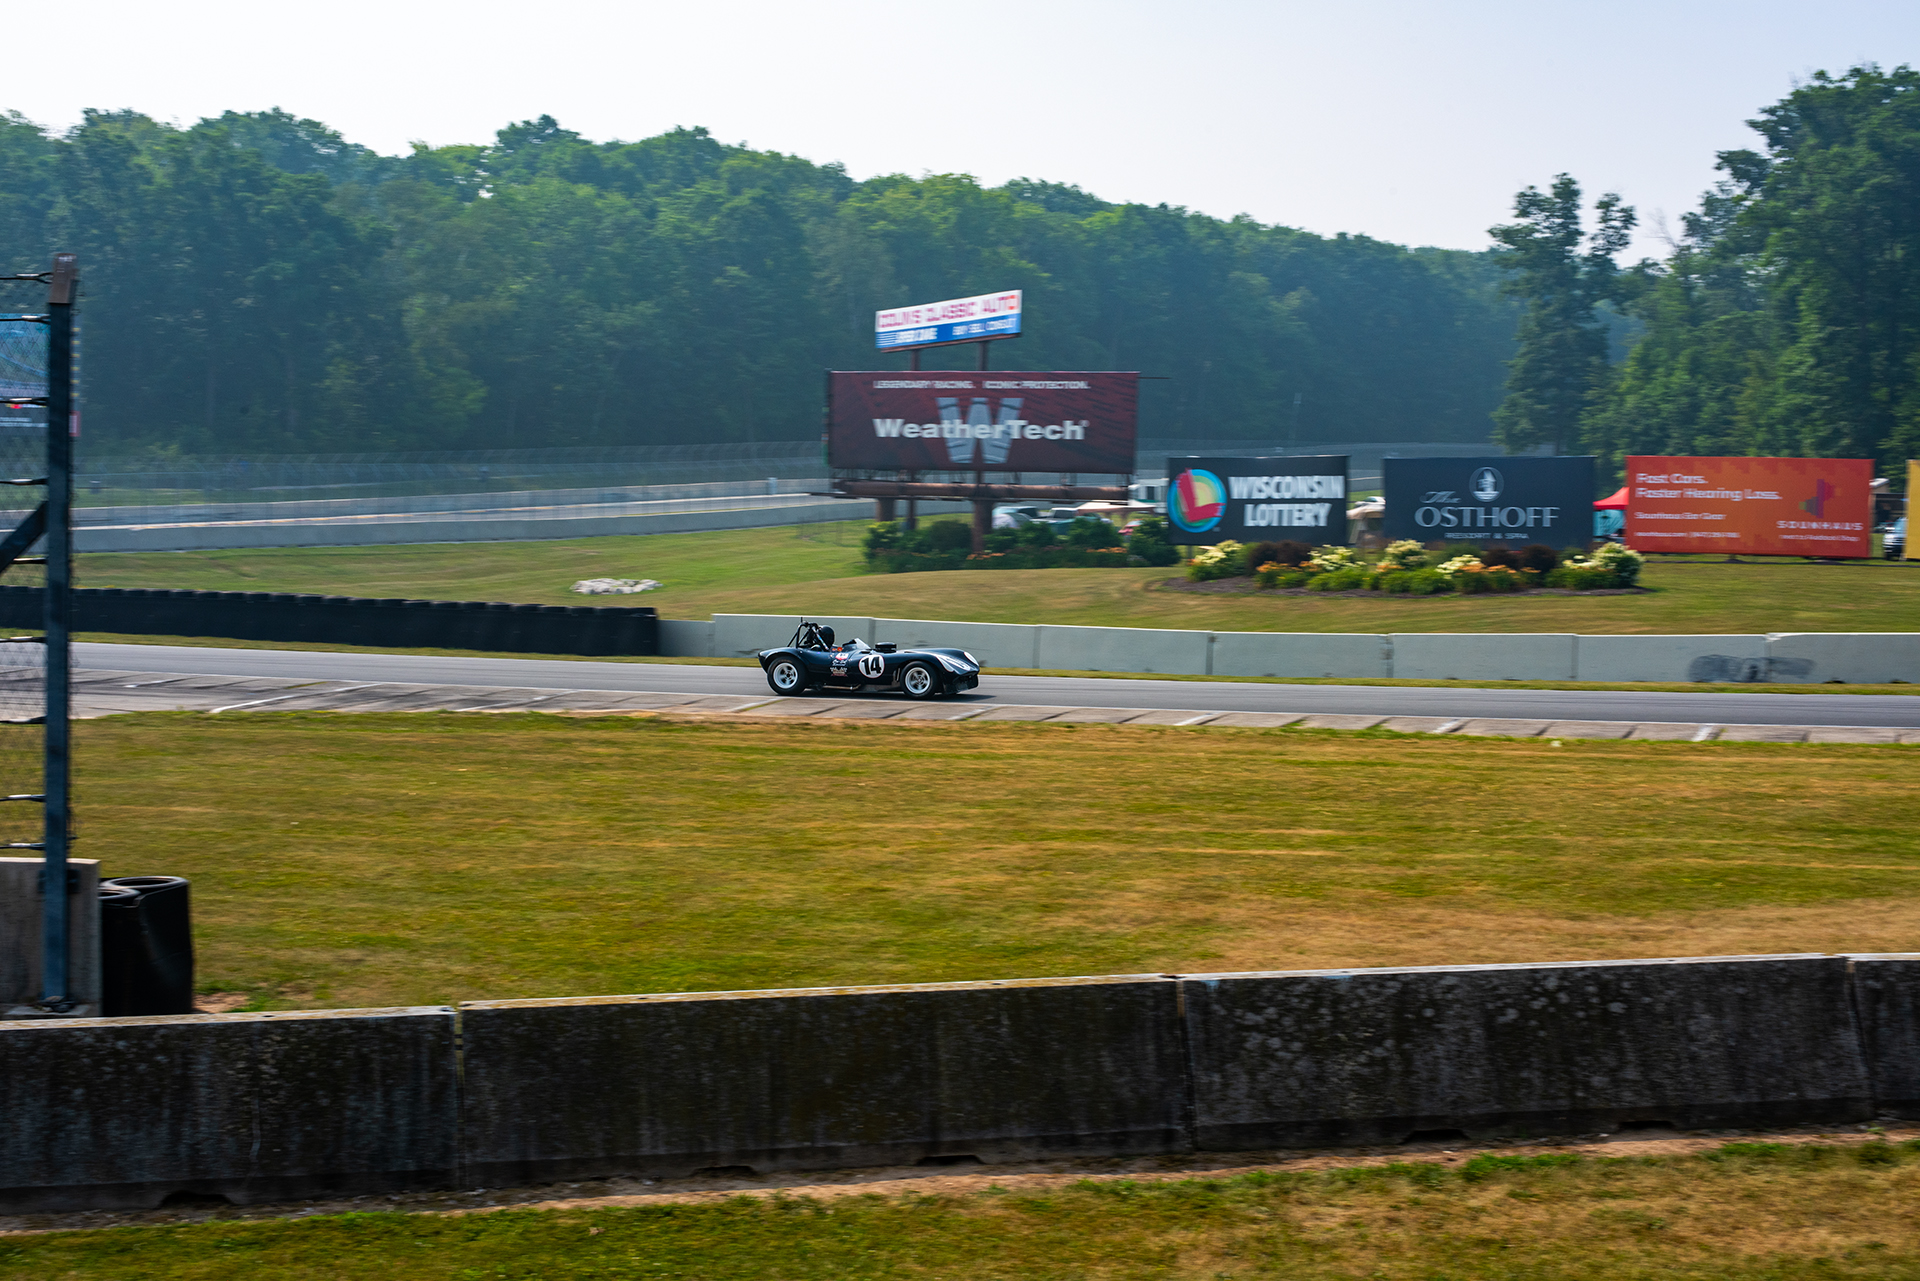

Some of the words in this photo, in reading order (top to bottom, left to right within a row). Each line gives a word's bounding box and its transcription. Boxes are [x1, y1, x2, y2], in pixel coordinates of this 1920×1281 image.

[980, 295, 1019, 314] AUTO
[1228, 475, 1345, 499] WISCONSIN
[1635, 473, 1669, 484] Fast
[1420, 490, 1462, 504] The
[1635, 487, 1682, 499] Faster
[1682, 487, 1743, 502] Hearing
[1243, 502, 1332, 527] LOTTERY
[1414, 506, 1561, 528] OSTHOFF
[861, 656, 882, 675] 14
